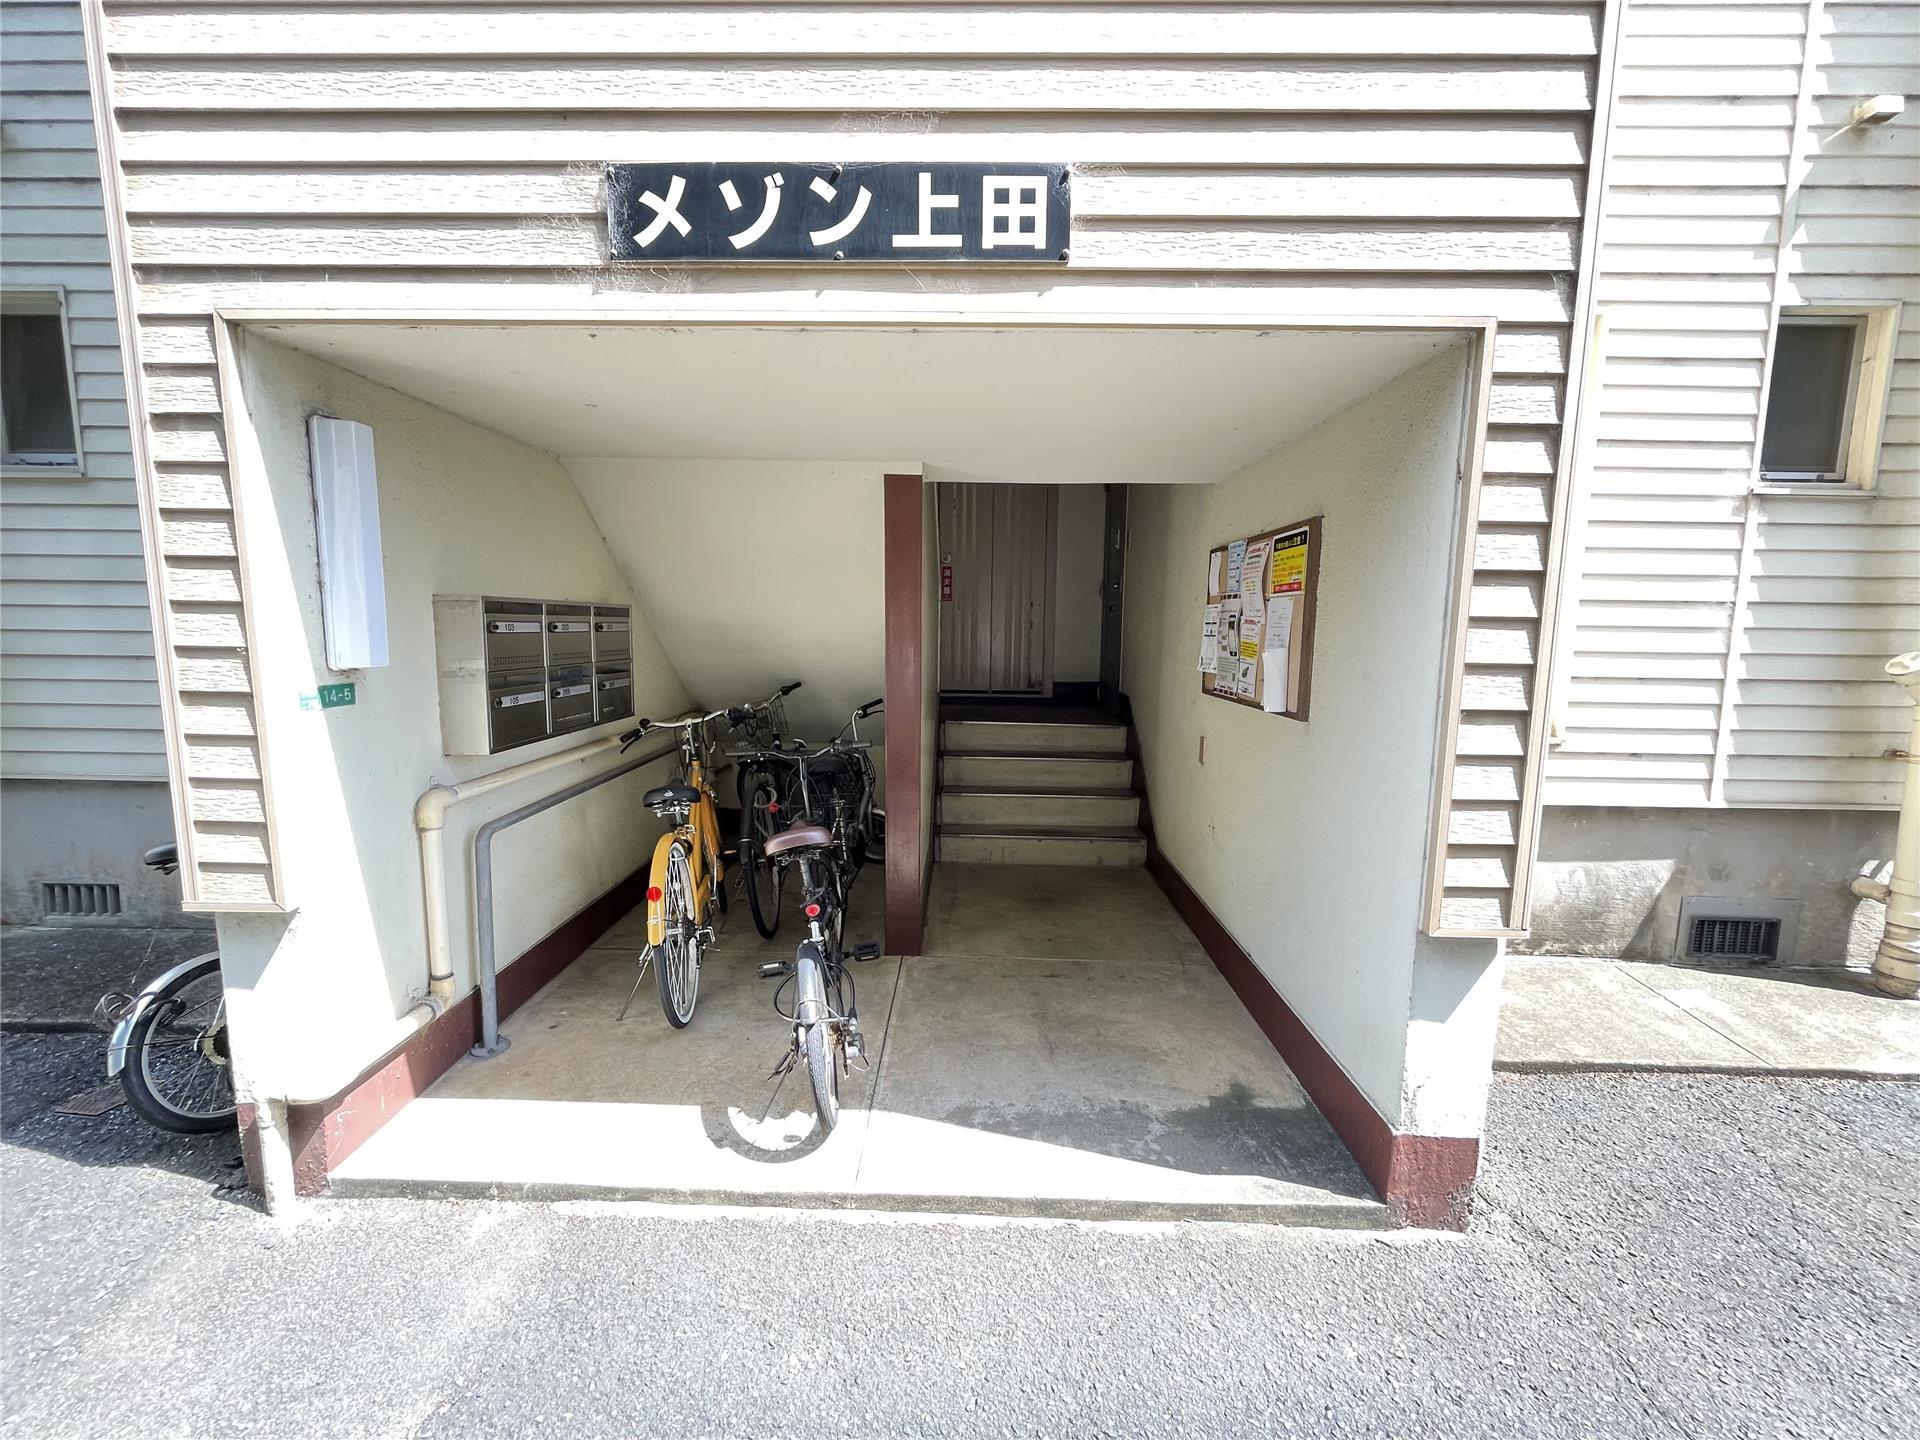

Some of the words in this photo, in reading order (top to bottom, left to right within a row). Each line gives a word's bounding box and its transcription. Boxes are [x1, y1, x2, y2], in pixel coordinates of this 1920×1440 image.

[632, 171, 1048, 250] メゾン上田
[322, 688, 352, 703] 14-5
